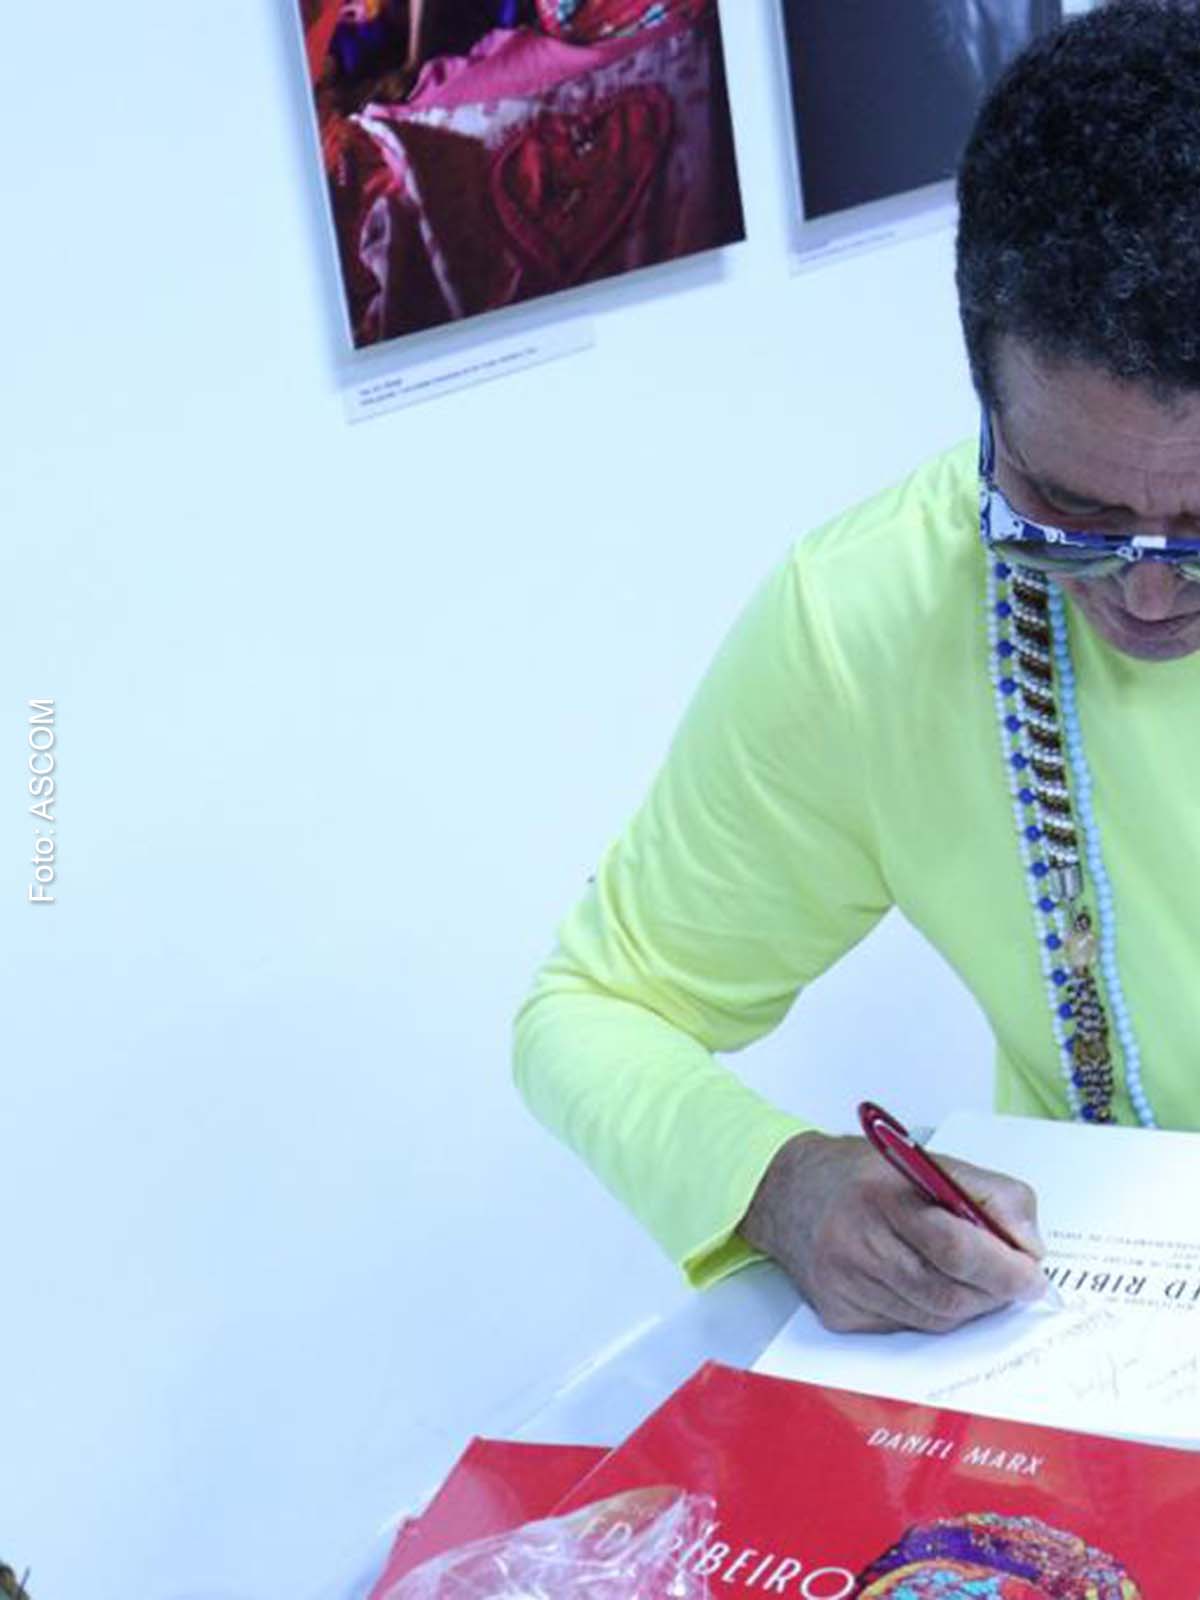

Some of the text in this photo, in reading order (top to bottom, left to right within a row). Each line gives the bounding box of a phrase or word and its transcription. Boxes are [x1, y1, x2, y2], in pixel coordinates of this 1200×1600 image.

[1043, 1266, 1147, 1296] RIBEIR
[867, 1427, 1045, 1477] DANIEL MARX
